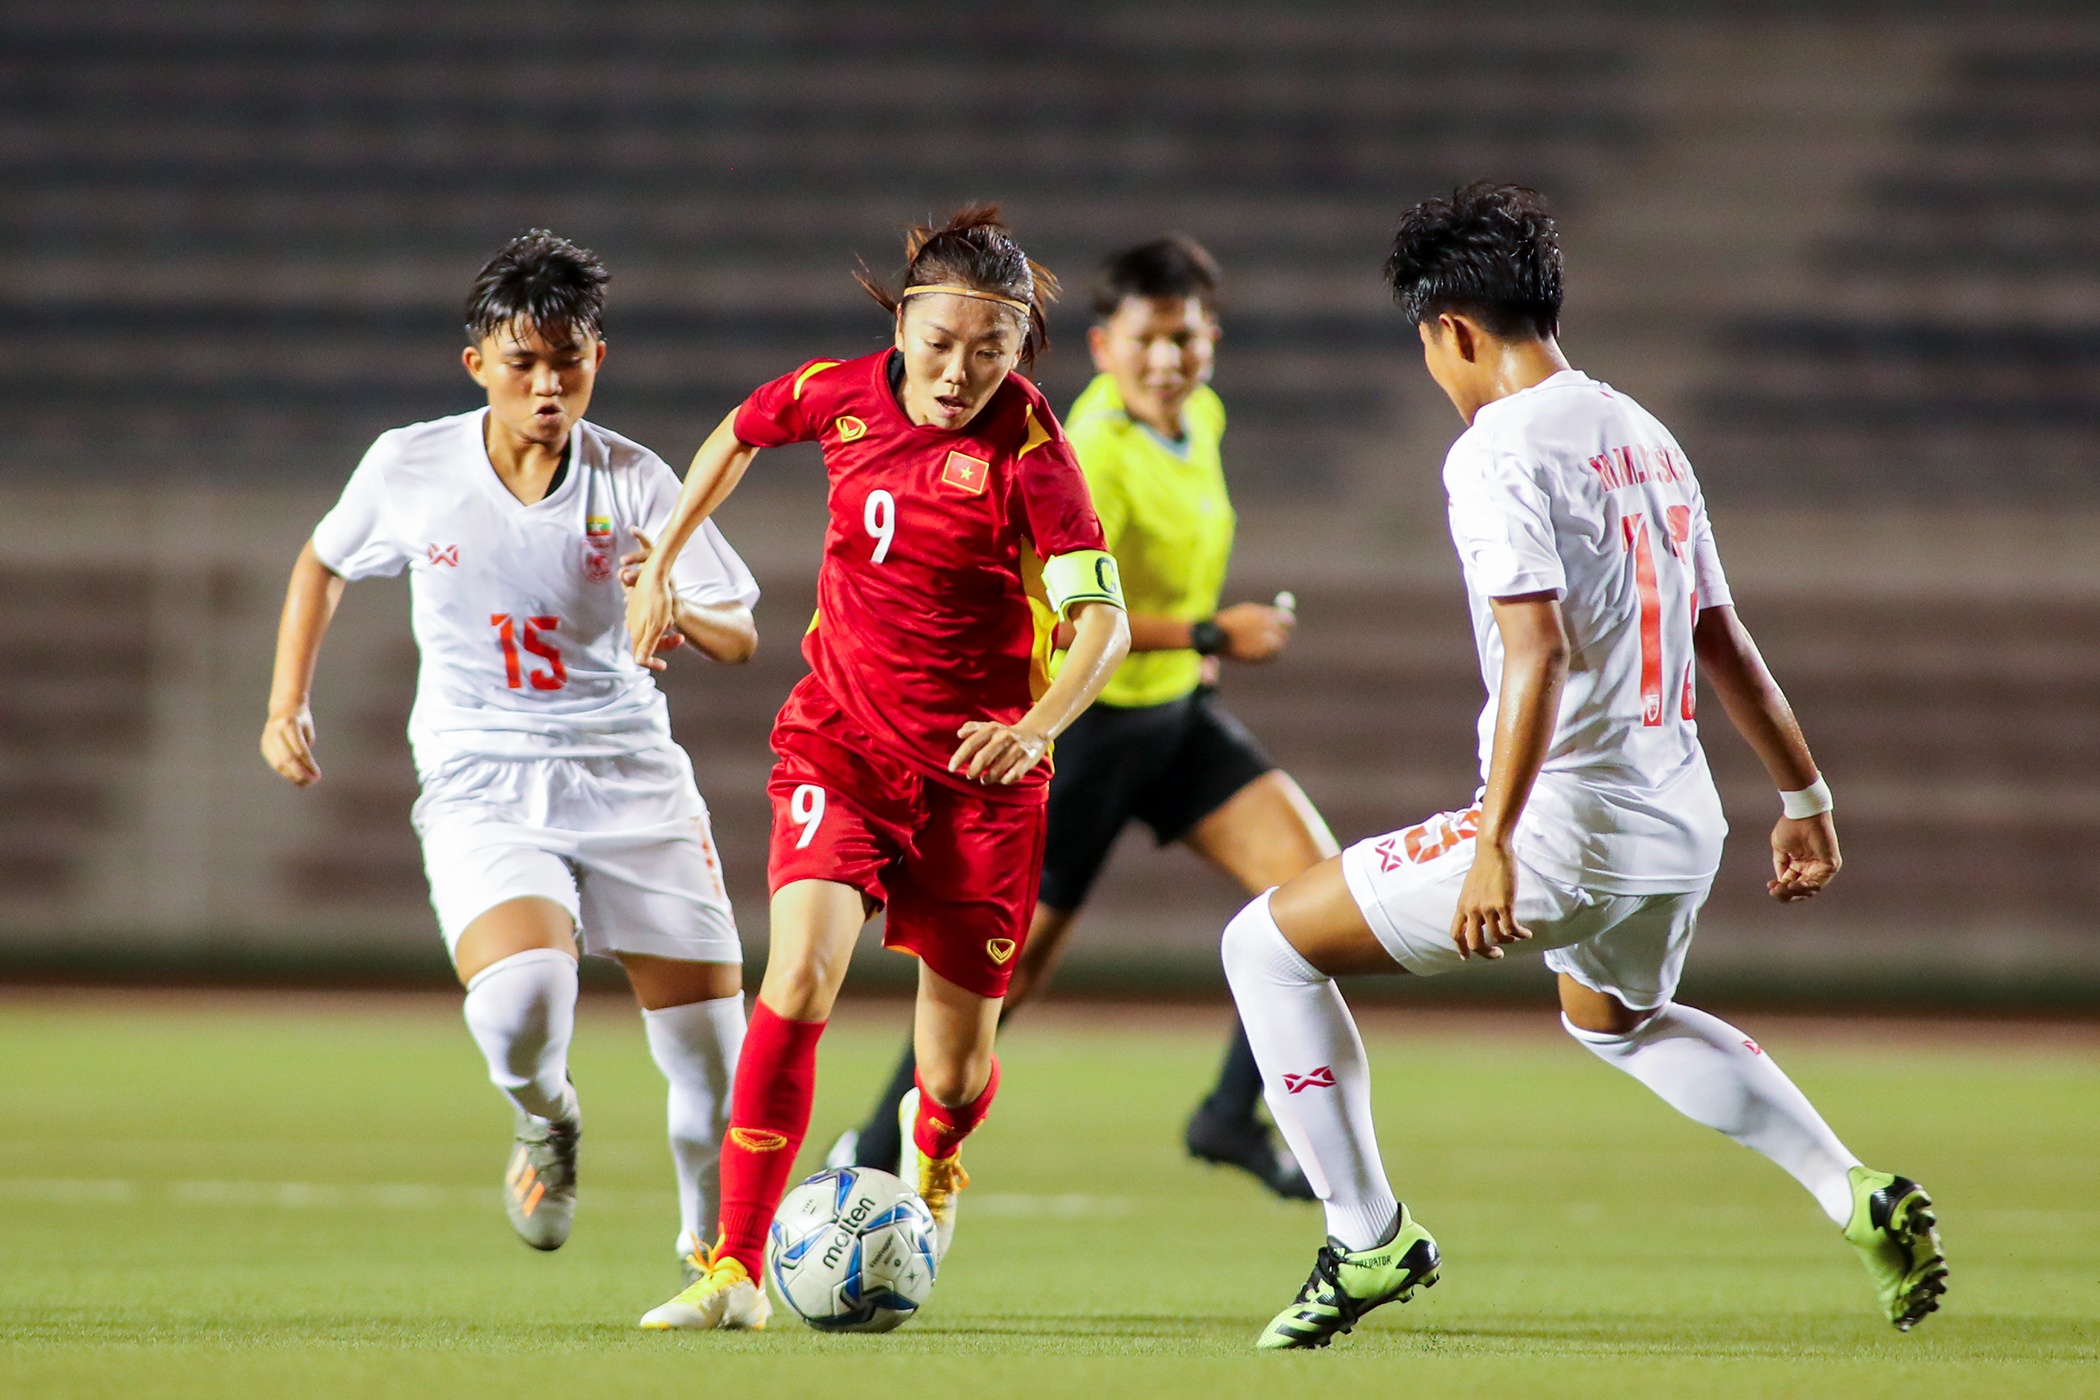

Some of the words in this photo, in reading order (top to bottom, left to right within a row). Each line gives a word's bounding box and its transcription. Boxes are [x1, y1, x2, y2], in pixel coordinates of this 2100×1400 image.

[864, 489, 895, 564] 9
[1094, 556, 1117, 594] C
[491, 613, 567, 691] 15
[791, 784, 826, 850] 9
[823, 1197, 876, 1269] molten
[1355, 1255, 1392, 1270] PREDATOR
